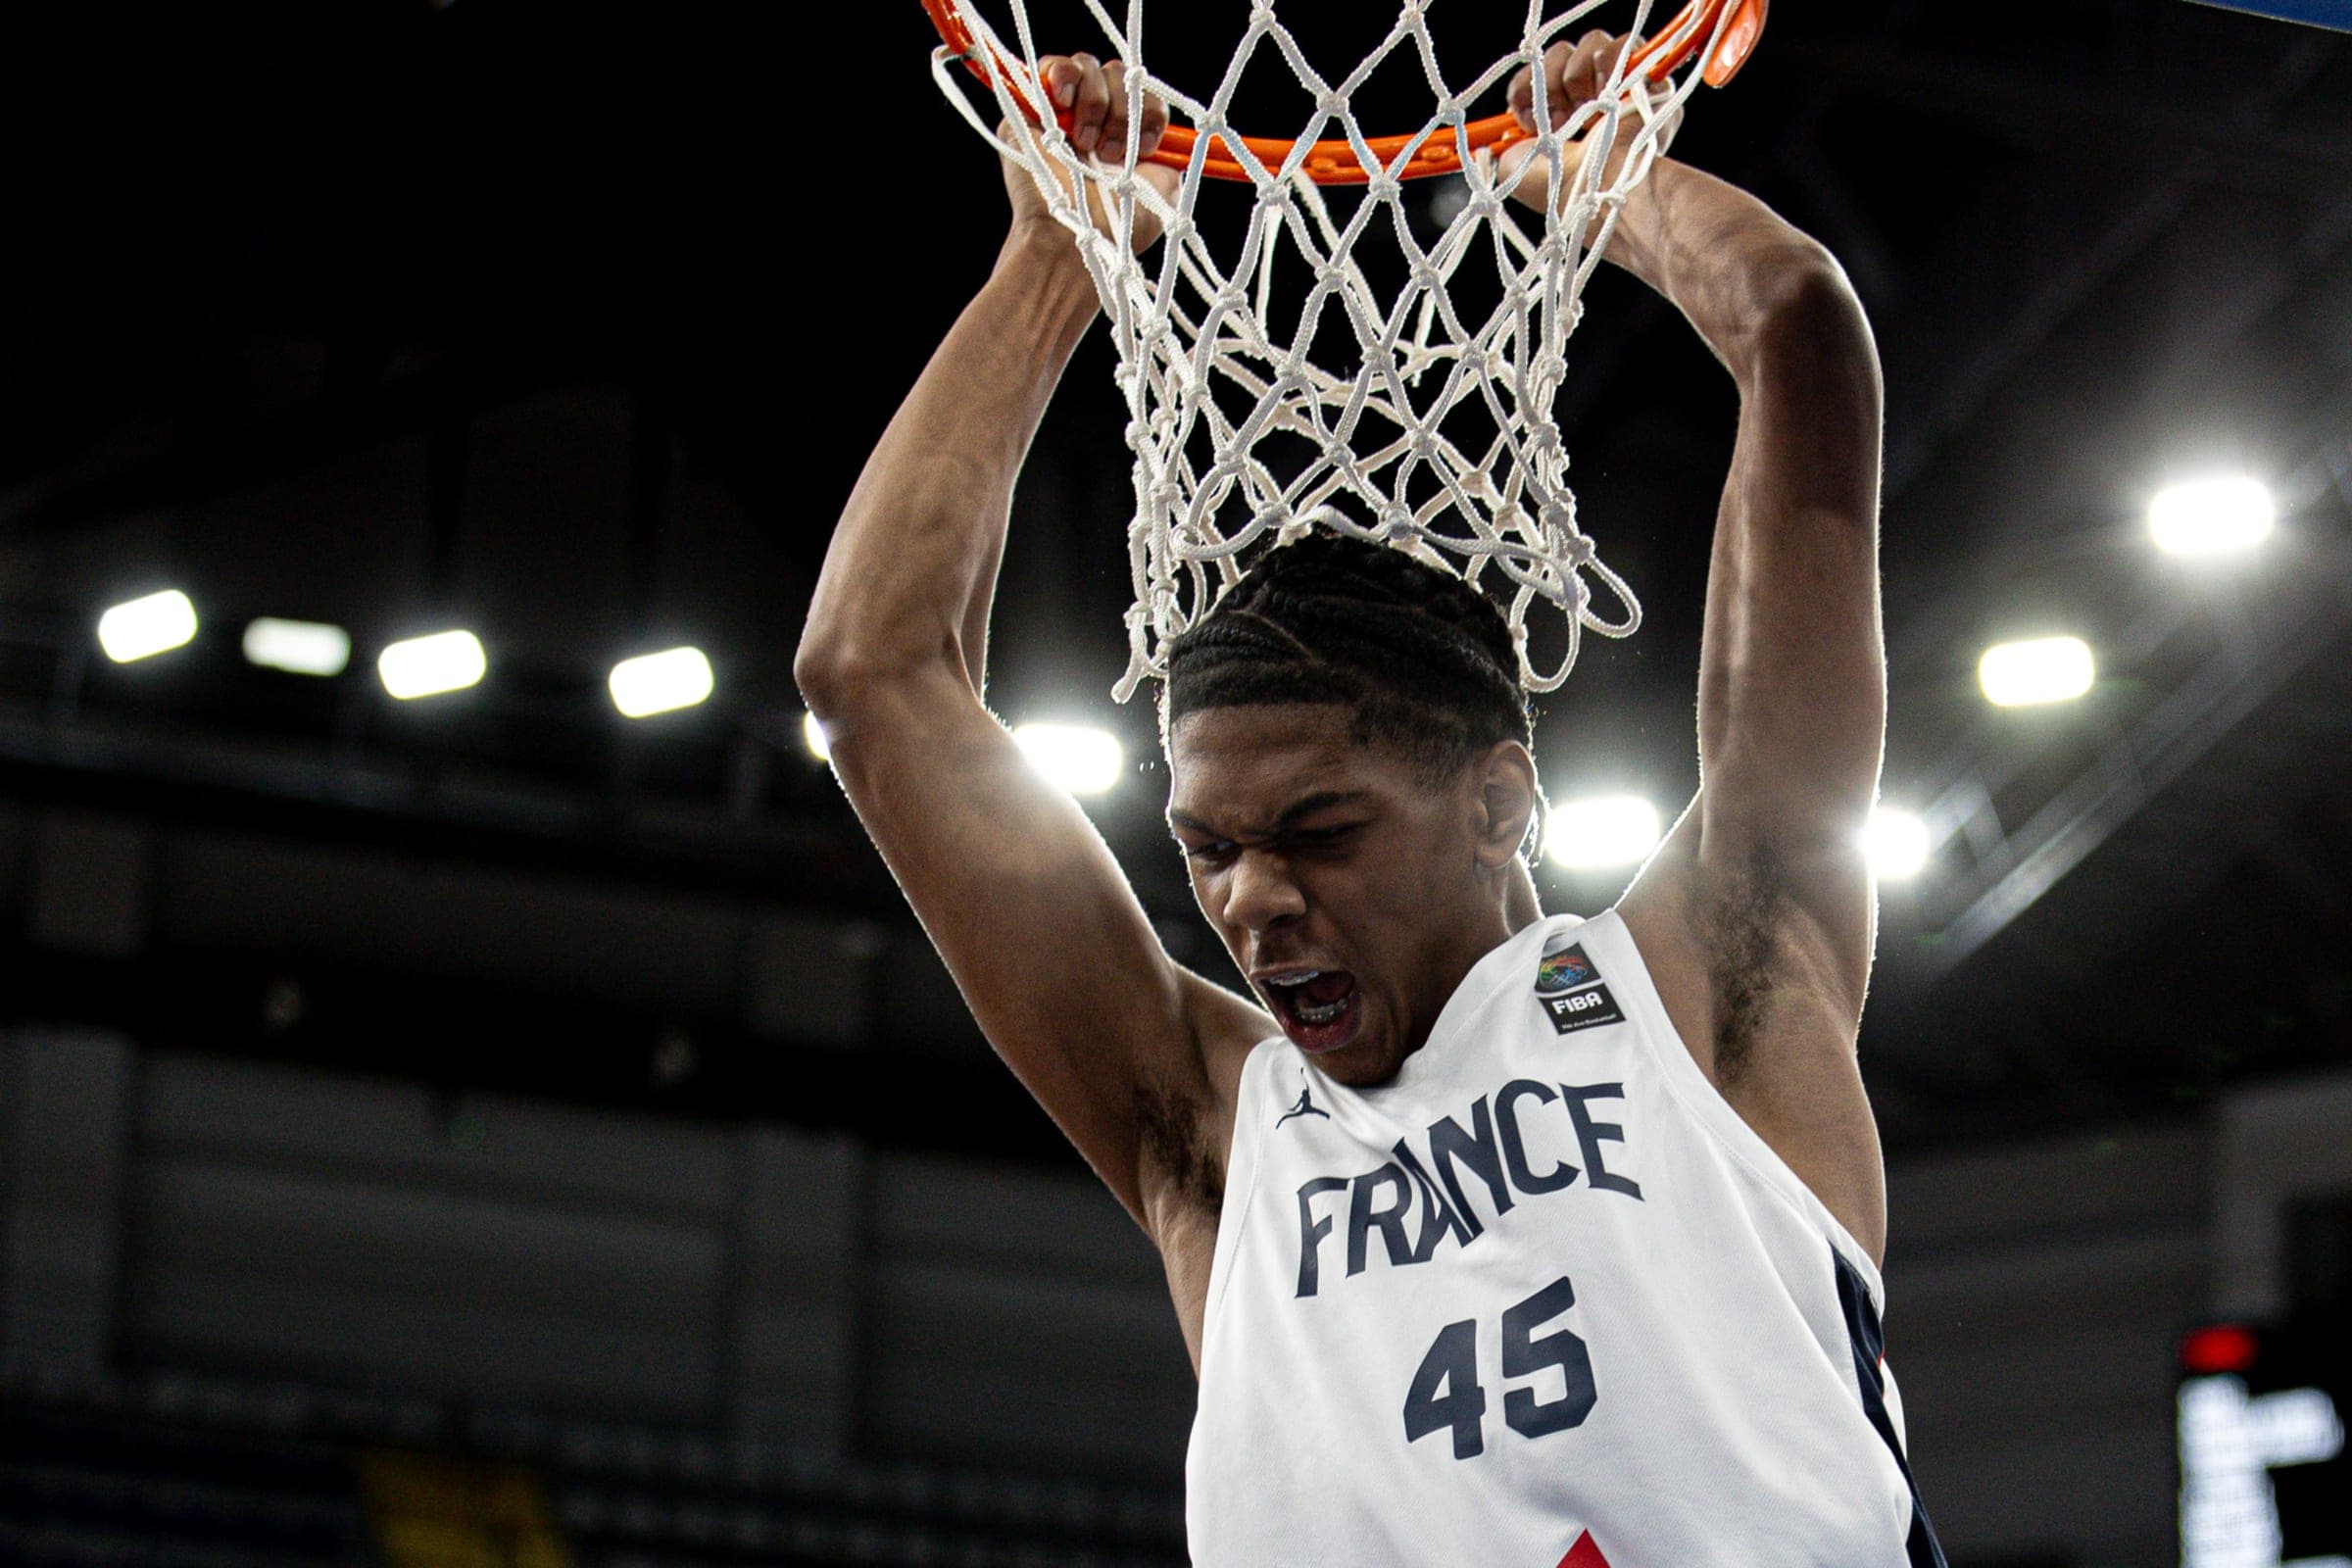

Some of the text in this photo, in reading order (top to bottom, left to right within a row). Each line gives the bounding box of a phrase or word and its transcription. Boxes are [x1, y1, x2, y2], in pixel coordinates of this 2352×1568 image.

[1551, 991, 1603, 1015] FIBA
[1294, 1079, 1645, 1299] FRANCE
[1402, 1275, 1598, 1461] 45
